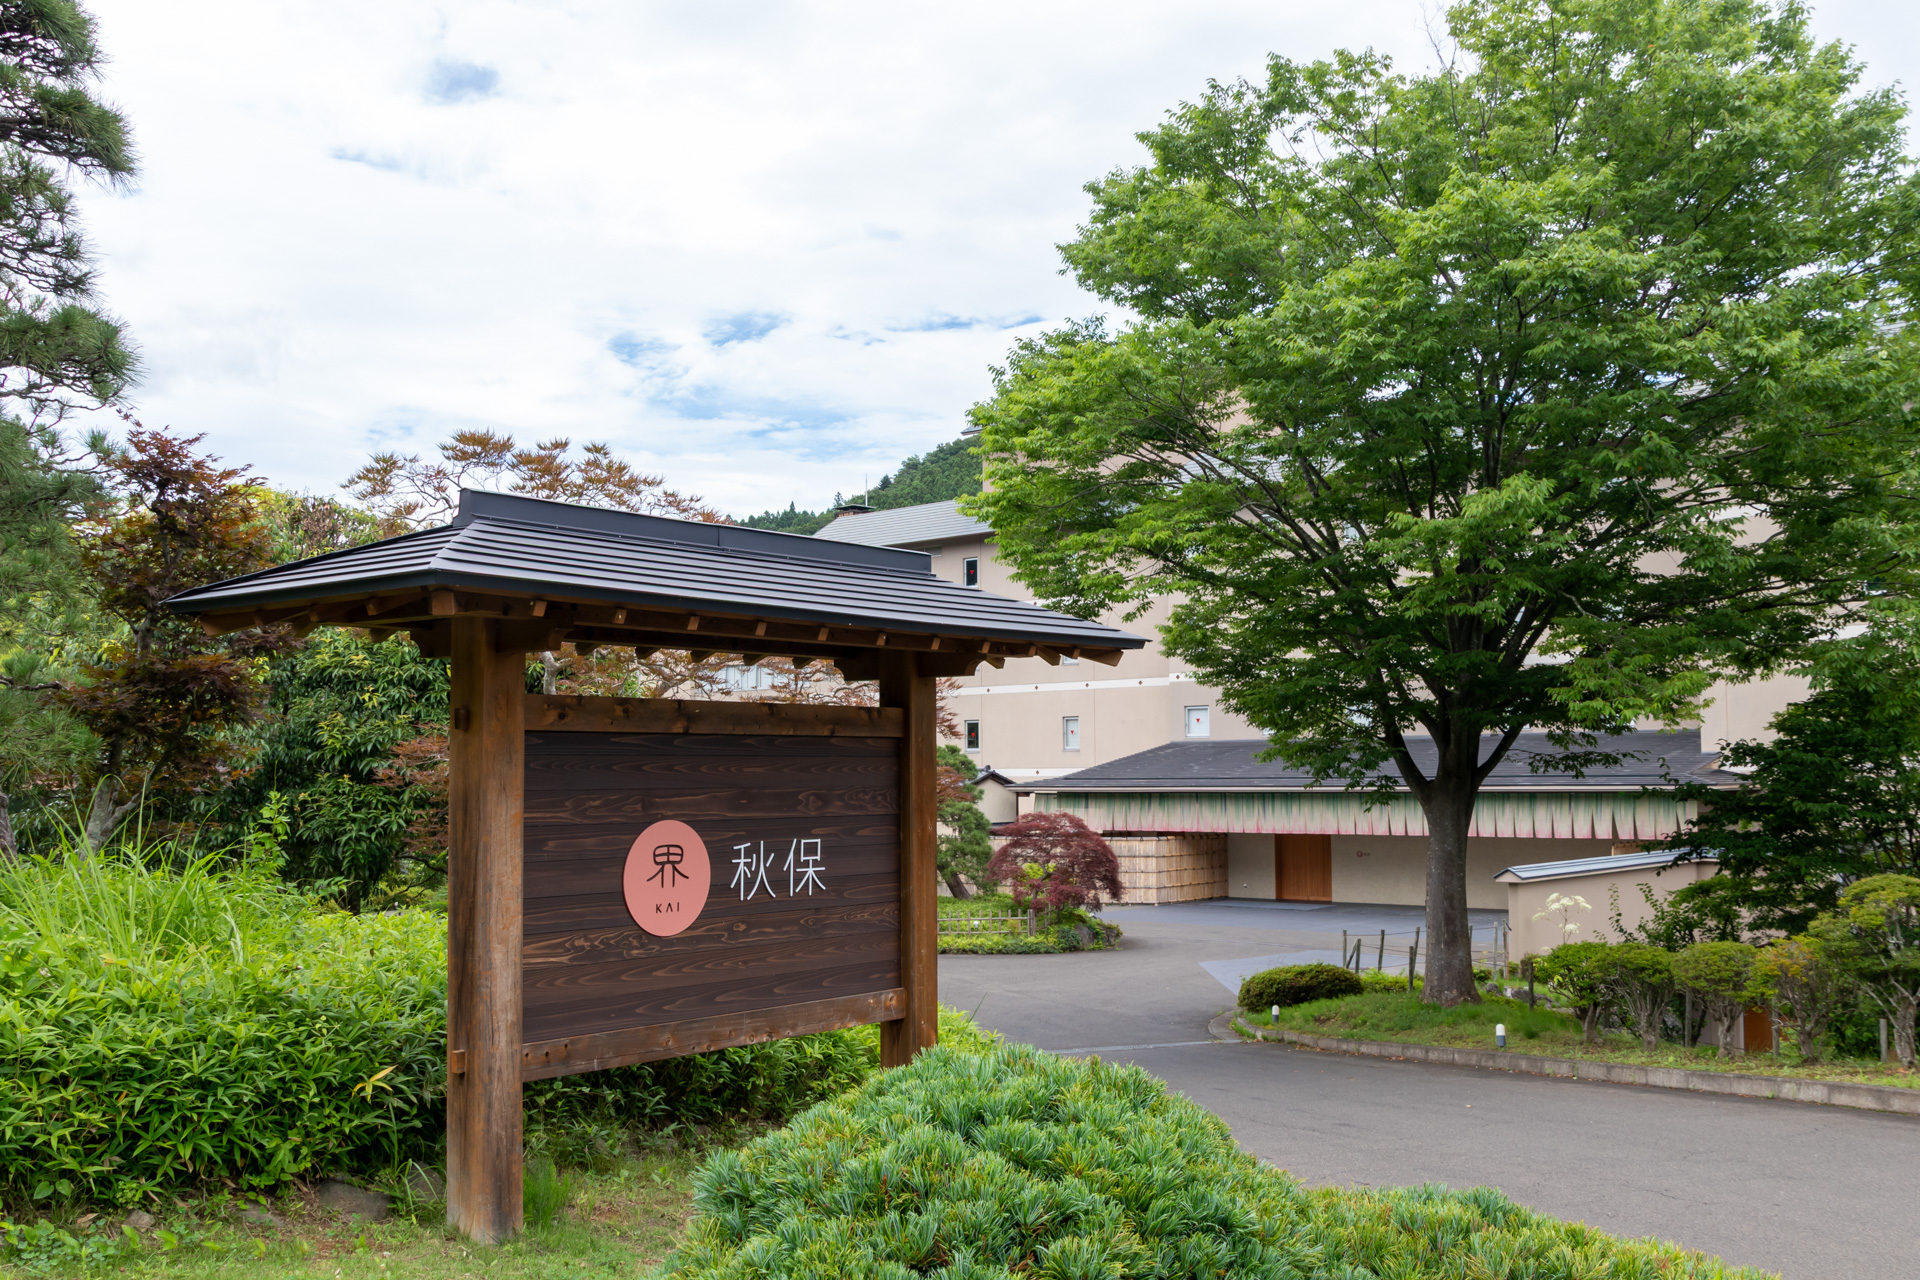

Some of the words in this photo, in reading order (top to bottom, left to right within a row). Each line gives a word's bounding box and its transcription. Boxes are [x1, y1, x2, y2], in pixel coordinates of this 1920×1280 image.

[646, 844, 690, 888] 界
[730, 838, 826, 900] 秋保
[655, 901, 680, 914] KAI
